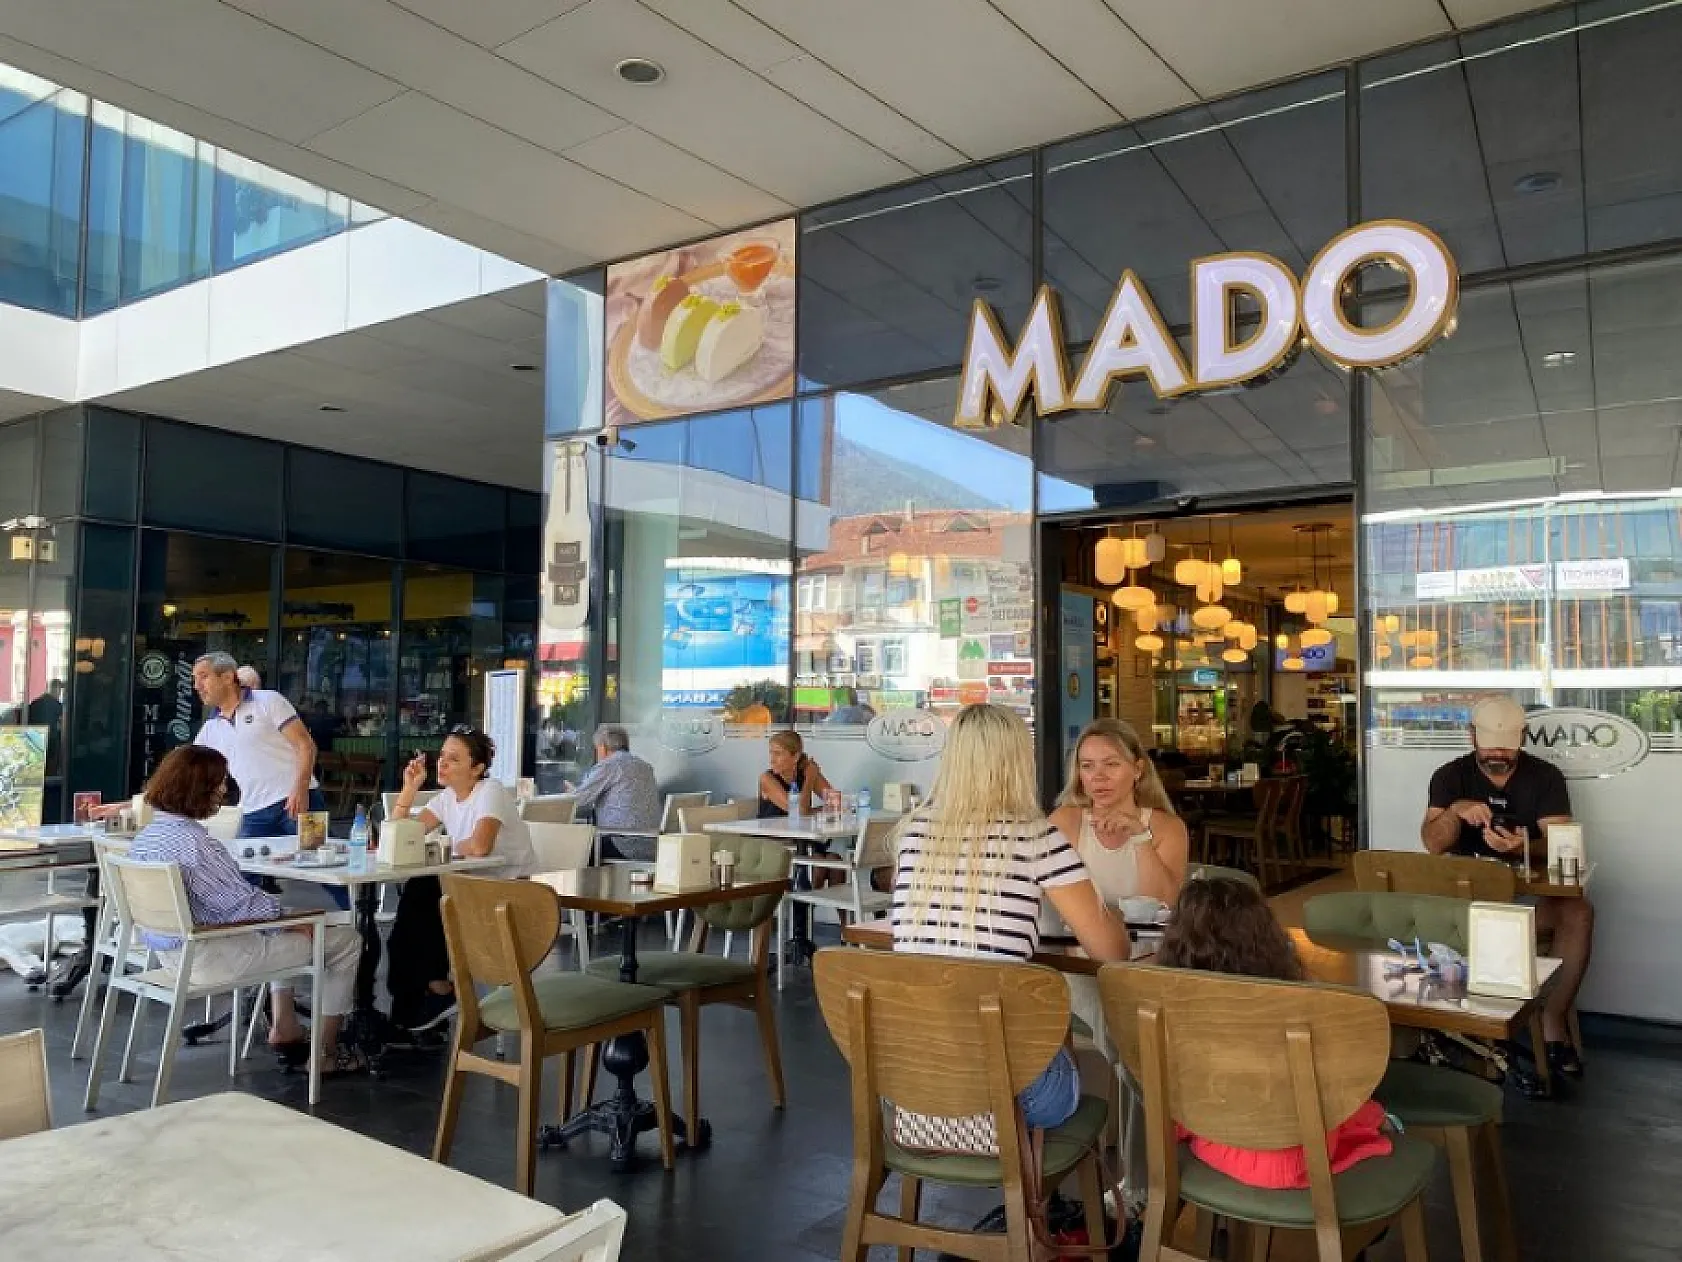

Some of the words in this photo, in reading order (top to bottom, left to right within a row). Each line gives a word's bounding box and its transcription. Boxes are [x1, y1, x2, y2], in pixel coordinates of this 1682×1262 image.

[953, 218, 1459, 428] MADO
[881, 718, 934, 737] MADO
[1522, 723, 1619, 748] MADO
